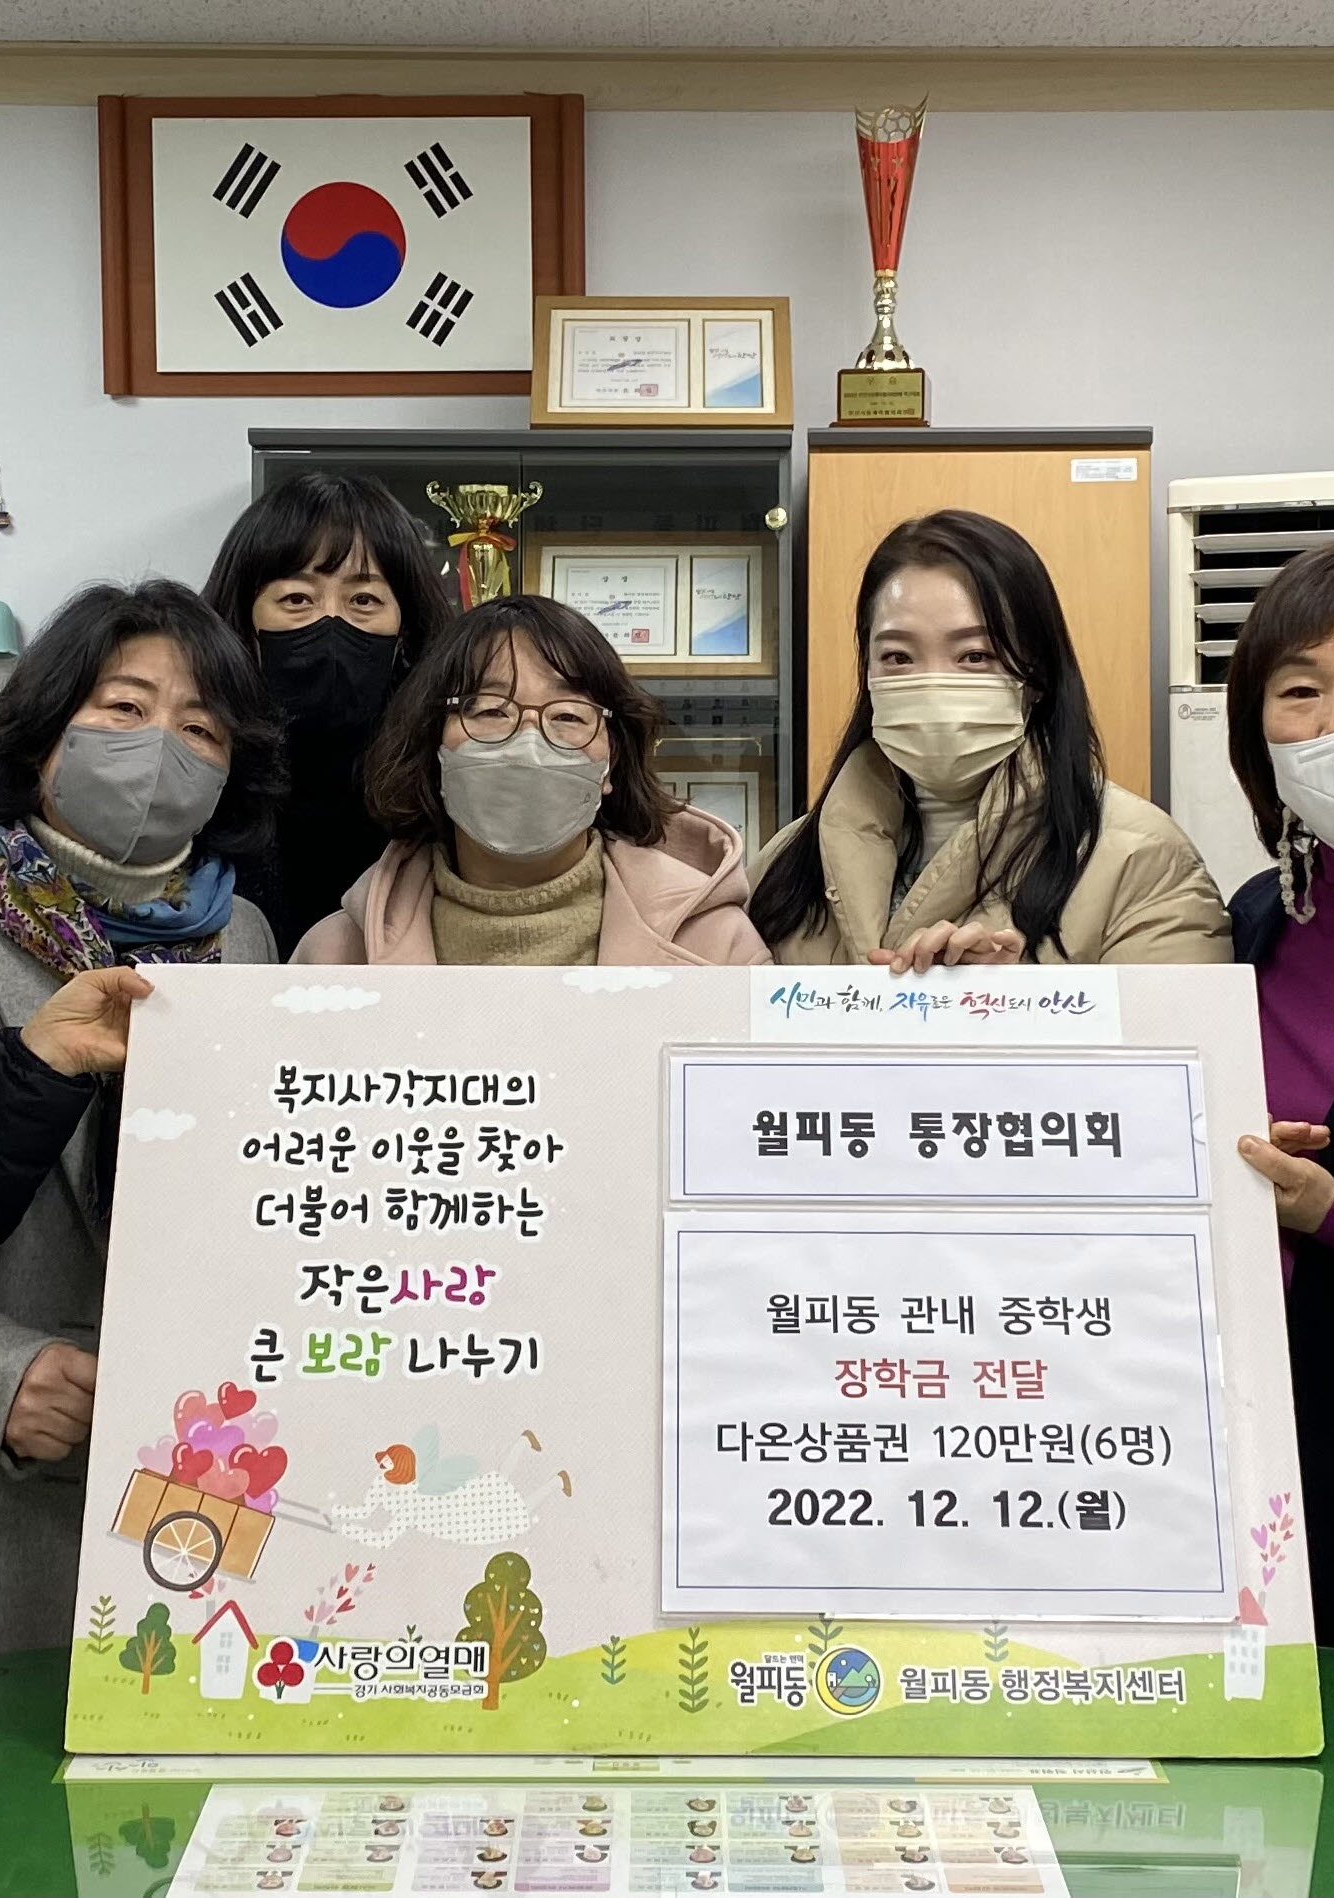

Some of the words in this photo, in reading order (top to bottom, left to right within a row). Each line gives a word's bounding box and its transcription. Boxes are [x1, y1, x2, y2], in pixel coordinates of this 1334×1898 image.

[769, 981, 833, 1019] 시민과
[836, 984, 881, 1013] 함께,
[889, 992, 952, 1021] 자유로운
[959, 991, 1032, 1020] 혁신도시
[1038, 990, 1096, 1015] 안산
[273, 1065, 535, 1114] 복지사각지대의
[242, 1126, 357, 1173] 어려운
[371, 1126, 465, 1176] 이웃을
[477, 1126, 564, 1173] 찾아
[752, 1110, 876, 1159] 월피동
[909, 1111, 1122, 1159] 통장협의회
[255, 1185, 368, 1237] 더불어
[385, 1186, 544, 1237] 함께하는
[300, 1263, 497, 1314] 작은사랑
[766, 1294, 880, 1335] 월피동
[900, 1295, 975, 1335] 관내
[998, 1295, 1112, 1337] 중학생
[250, 1328, 285, 1383] 큰
[302, 1331, 392, 1377] 보람
[408, 1333, 538, 1379] 나누기
[834, 1357, 950, 1399] 장학금
[972, 1359, 1048, 1400] 전달
[717, 1421, 909, 1463] 다온상품권
[932, 1423, 1171, 1467] 120만원(6명)
[767, 1488, 884, 1527] 2022.
[907, 1489, 969, 1528] 12.
[992, 1489, 1126, 1531] 12.(월)
[313, 1644, 487, 1682] 사랑의열매
[730, 1659, 808, 1708] 월피동
[898, 1667, 991, 1702] 월피동
[1000, 1666, 1186, 1704] 행정복지센터
[355, 1684, 378, 1698] 경기
[380, 1684, 484, 1700] 사회복지공동모금회
